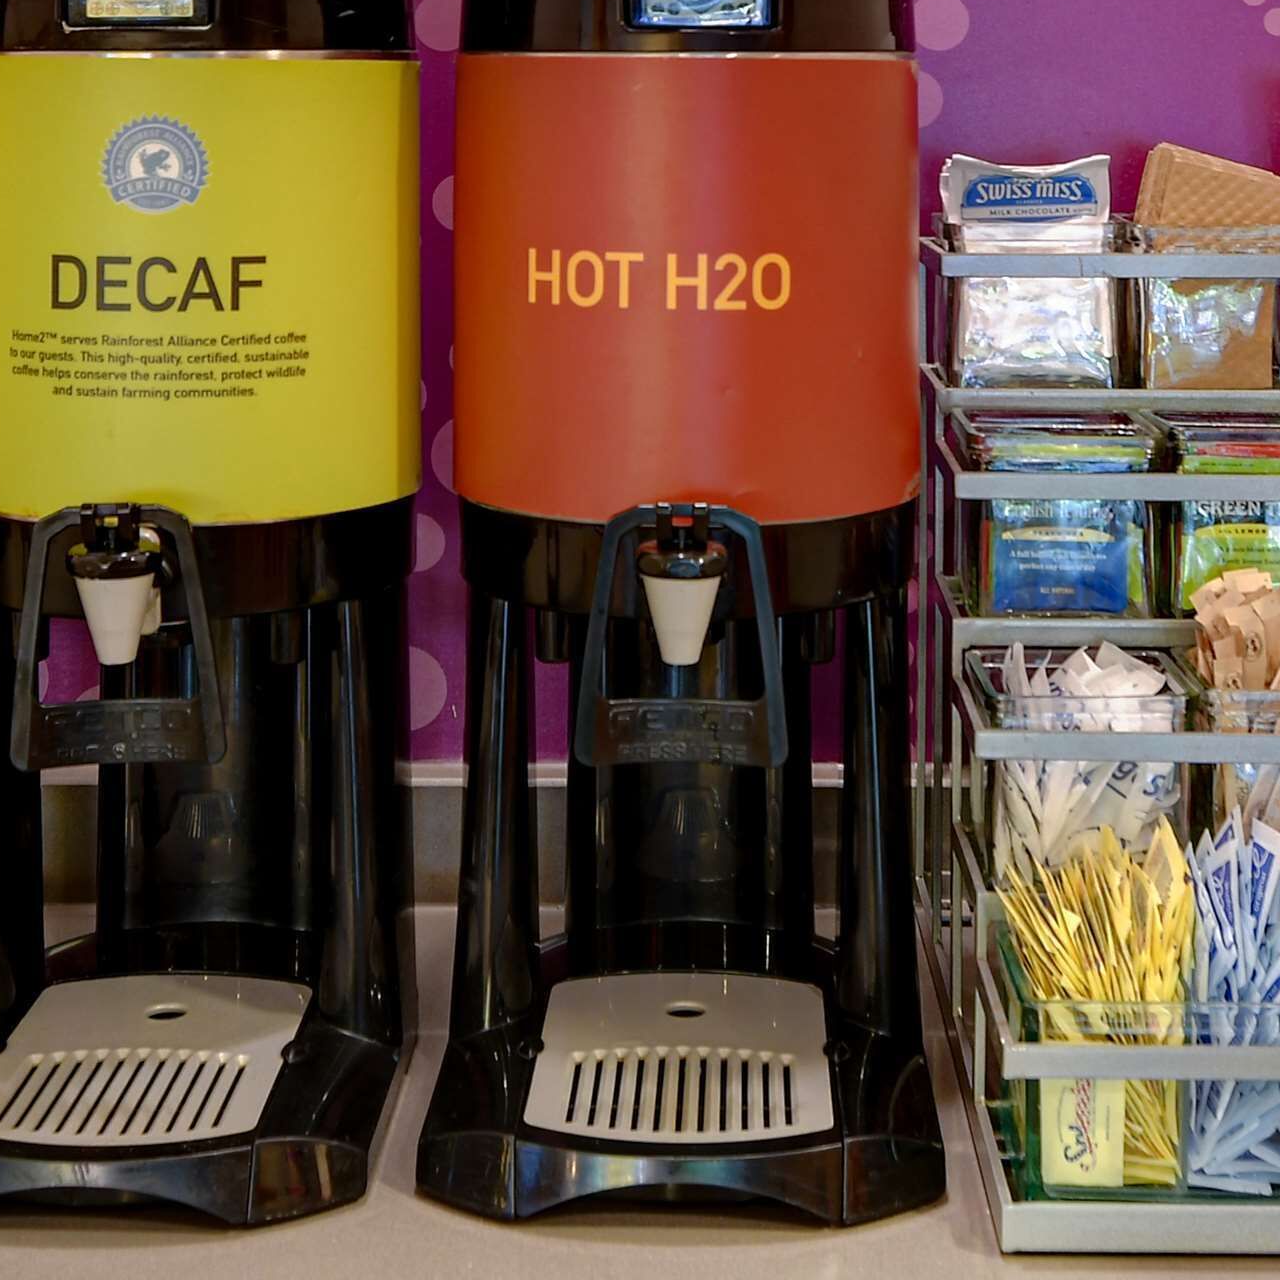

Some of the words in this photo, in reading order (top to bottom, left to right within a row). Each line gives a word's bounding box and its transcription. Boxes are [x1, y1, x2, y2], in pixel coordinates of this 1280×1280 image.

[117, 178, 192, 198] CERTIFIED
[989, 208, 1013, 216] MILK
[1015, 207, 1071, 215] CHOCOLATE
[51, 254, 267, 312] DECAF
[528, 247, 644, 309] HOT
[60, 335, 98, 345] serves
[101, 335, 163, 347] Rainforest
[168, 335, 217, 347] Alliance
[220, 333, 271, 346] Certified
[274, 332, 307, 345] coffee
[9, 347, 19, 358] to
[20, 349, 36, 359] our
[80, 351, 105, 363] This
[244, 349, 310, 362] sustainable
[12, 365, 40, 376] coffee
[42, 367, 71, 380] helps
[73, 370, 128, 380] conserve
[130, 370, 150, 380] the
[221, 369, 263, 382] protect
[266, 365, 307, 377] wildlife
[52, 385, 73, 396] and
[75, 387, 118, 397] sustain
[121, 387, 170, 401] farming
[174, 386, 257, 398] communities.
[1197, 500, 1261, 517] GREEN
